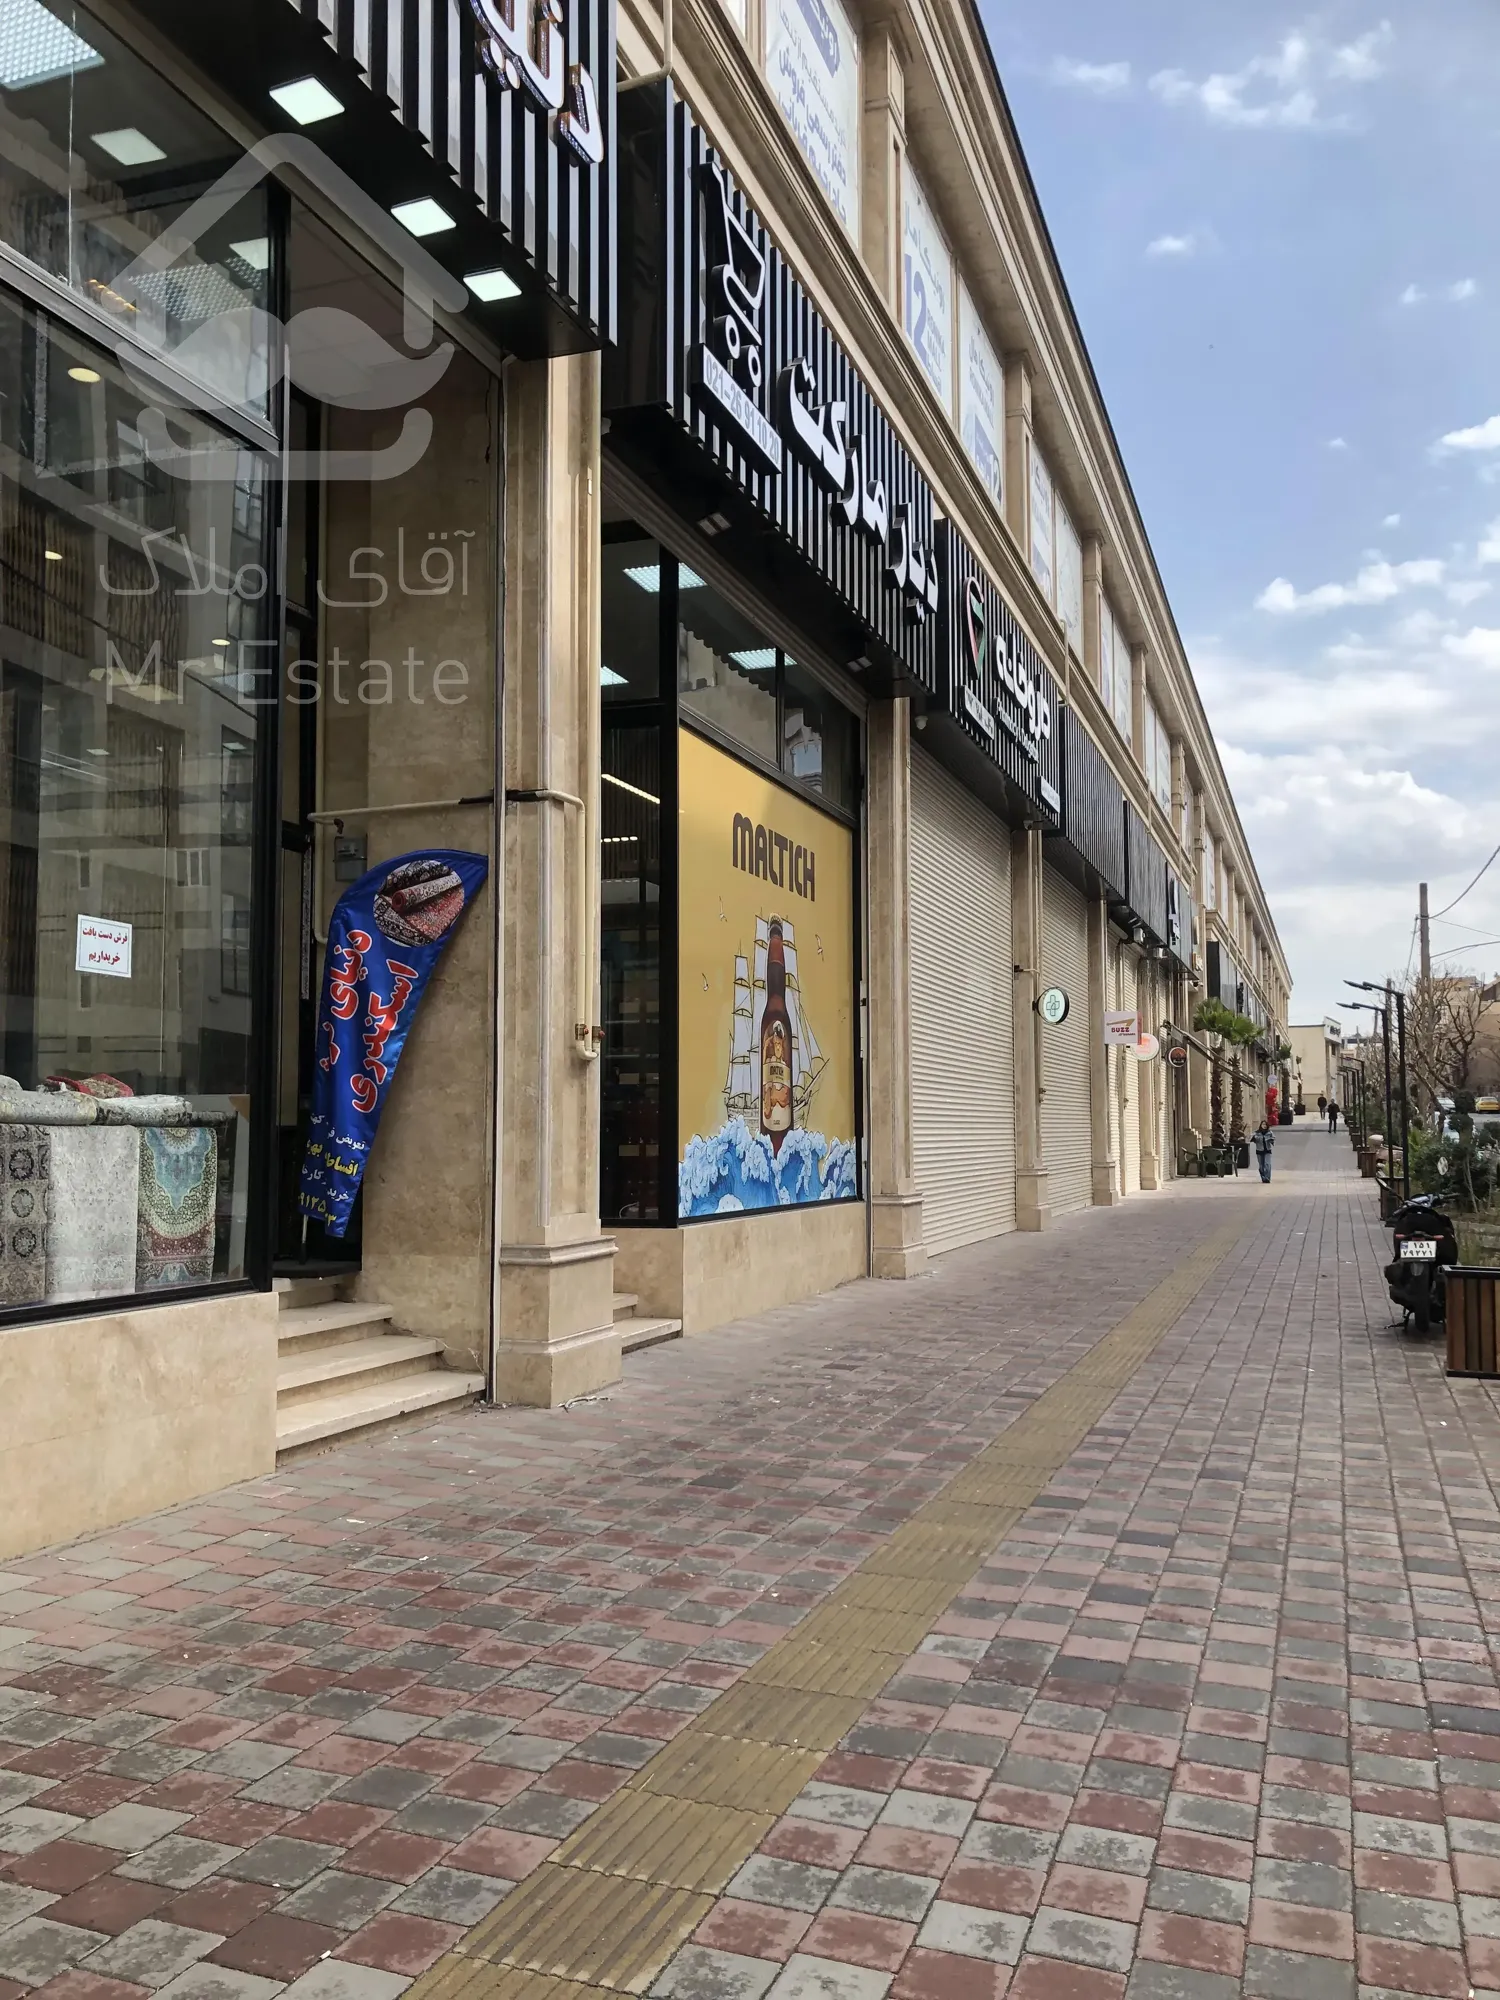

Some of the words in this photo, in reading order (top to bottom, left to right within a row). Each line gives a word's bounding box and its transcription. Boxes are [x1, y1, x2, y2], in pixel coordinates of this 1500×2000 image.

[779, 47, 805, 108] فروش
[806, 103, 830, 163] رسمی
[831, 146, 847, 188] دفتر
[904, 253, 927, 369] 12
[706, 354, 742, 420] 021-26
[745, 401, 755, 436] 91
[757, 416, 767, 450] 10
[769, 432, 780, 464] 20
[789, 357, 889, 545] مارکت
[892, 502, 938, 624] دیار
[732, 812, 815, 902] MALTICH
[82, 926, 96, 939] بافت
[88, 951, 120, 965] خریداریم
[98, 930, 112, 939] دست
[114, 932, 128, 944] فرش
[330, 929, 372, 1020] دنیای
[350, 959, 419, 1113] اسکندری
[335, 1134, 366, 1150] تعویض
